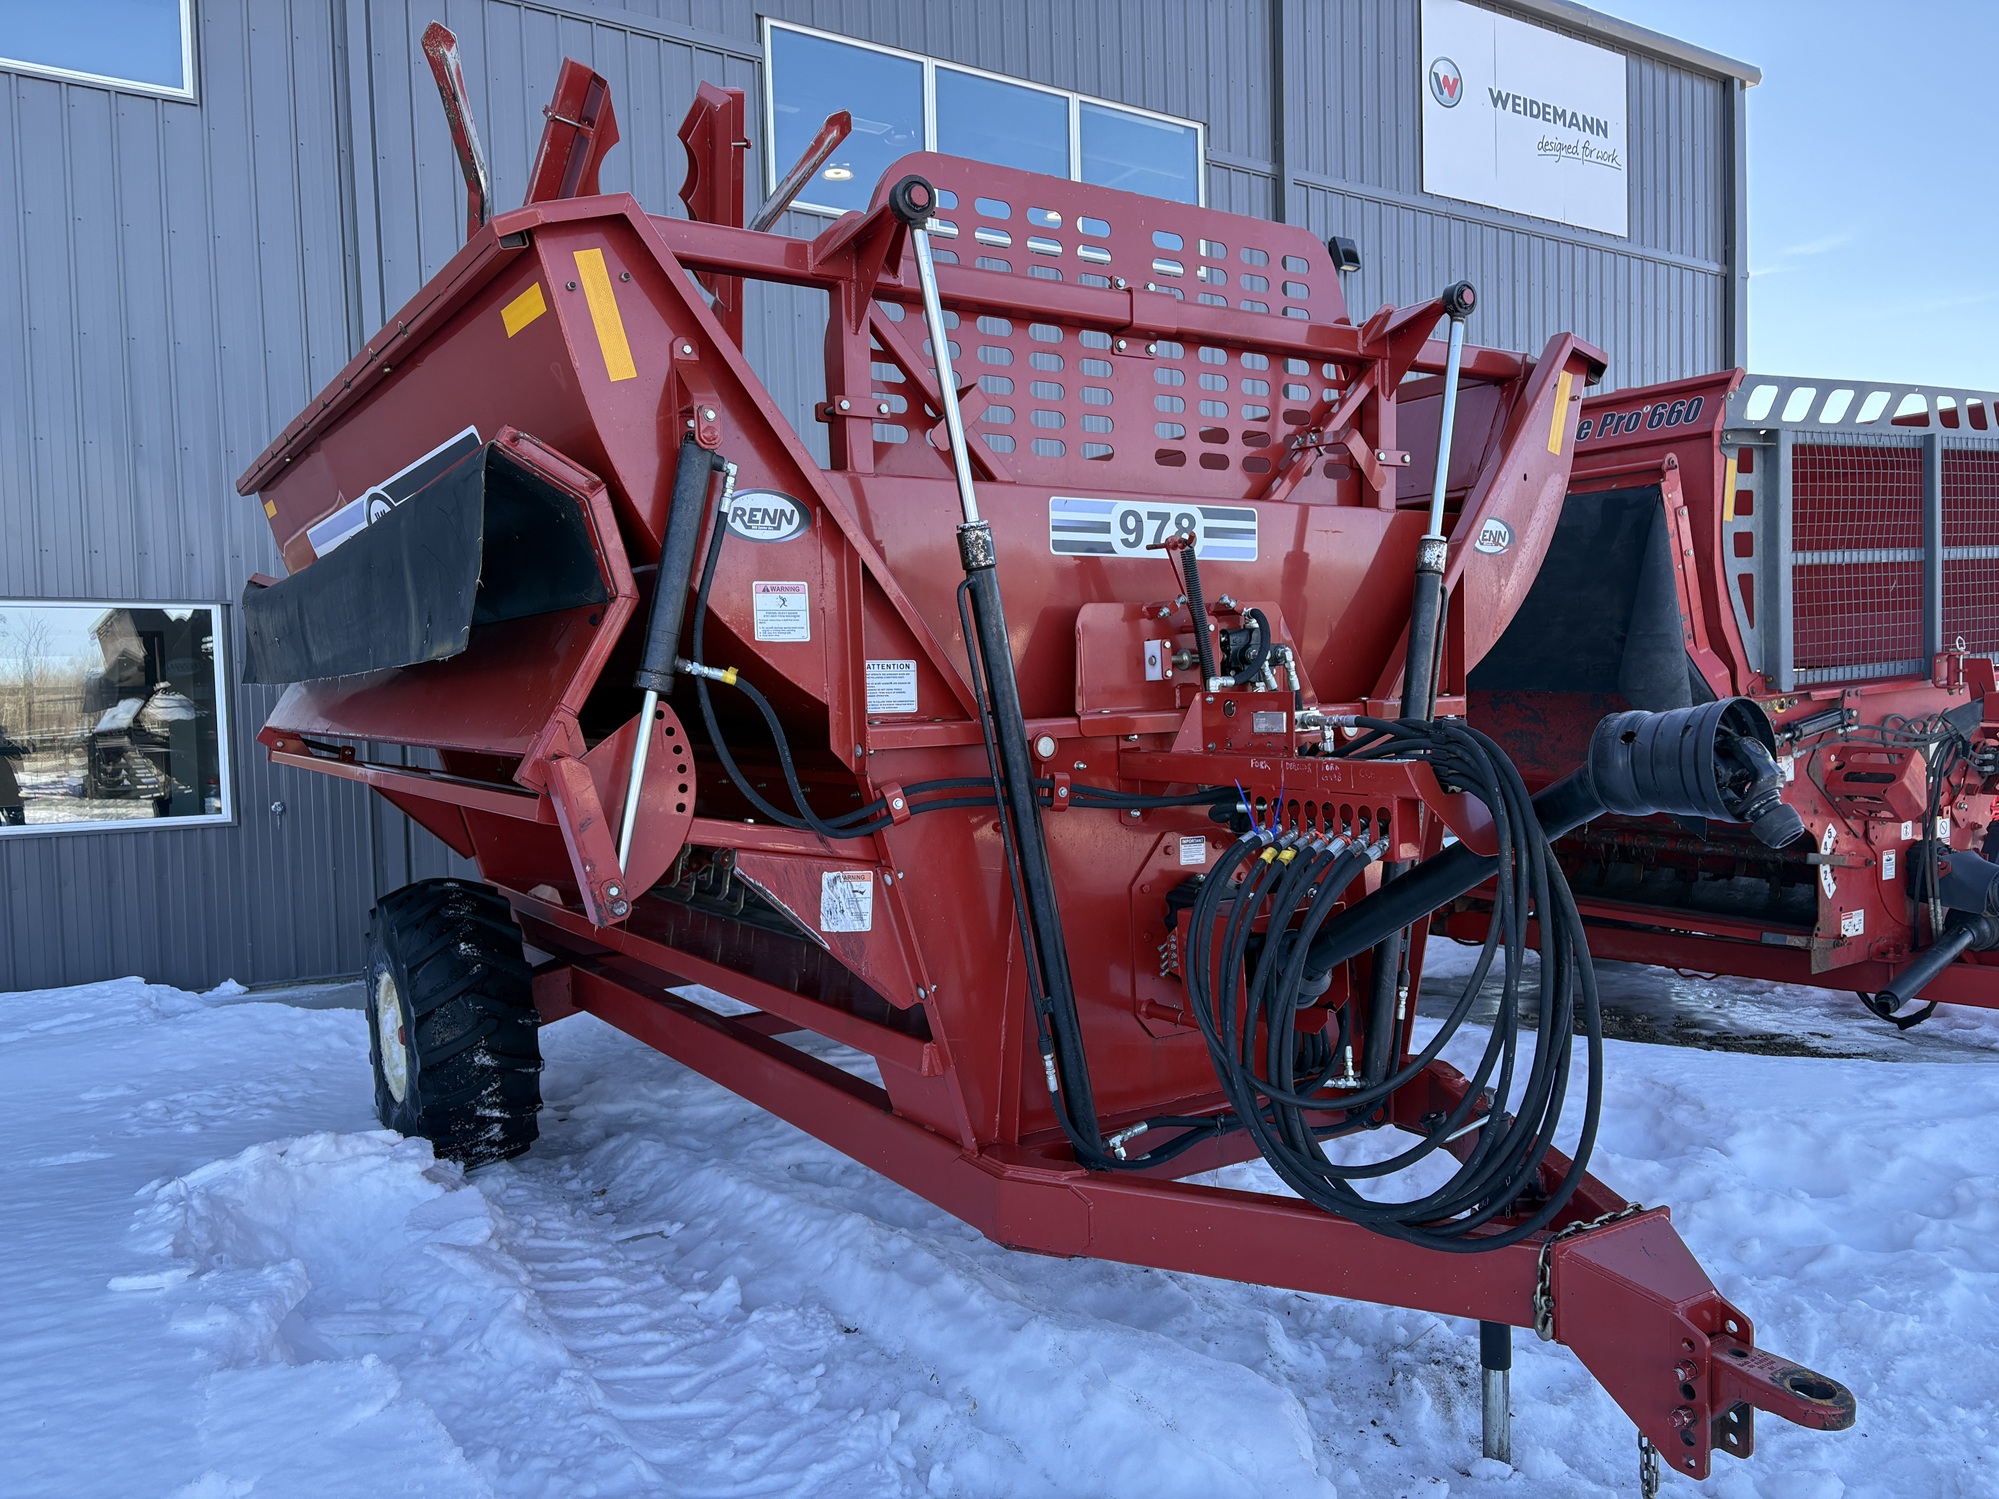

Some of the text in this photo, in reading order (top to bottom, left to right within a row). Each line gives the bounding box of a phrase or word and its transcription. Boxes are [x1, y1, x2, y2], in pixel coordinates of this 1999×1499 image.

[1487, 87, 1609, 139] WEIDEMANN
[1581, 139, 1596, 165] for
[1596, 147, 1622, 167] work
[1646, 395, 1705, 430] 660
[730, 506, 796, 531] RENN
[1119, 509, 1197, 549] 978
[770, 585, 800, 593] WARNING
[1827, 828, 1833, 839] 5
[1823, 841, 1828, 851] 4
[1823, 870, 1828, 880] 2
[1827, 883, 1832, 893] 1
